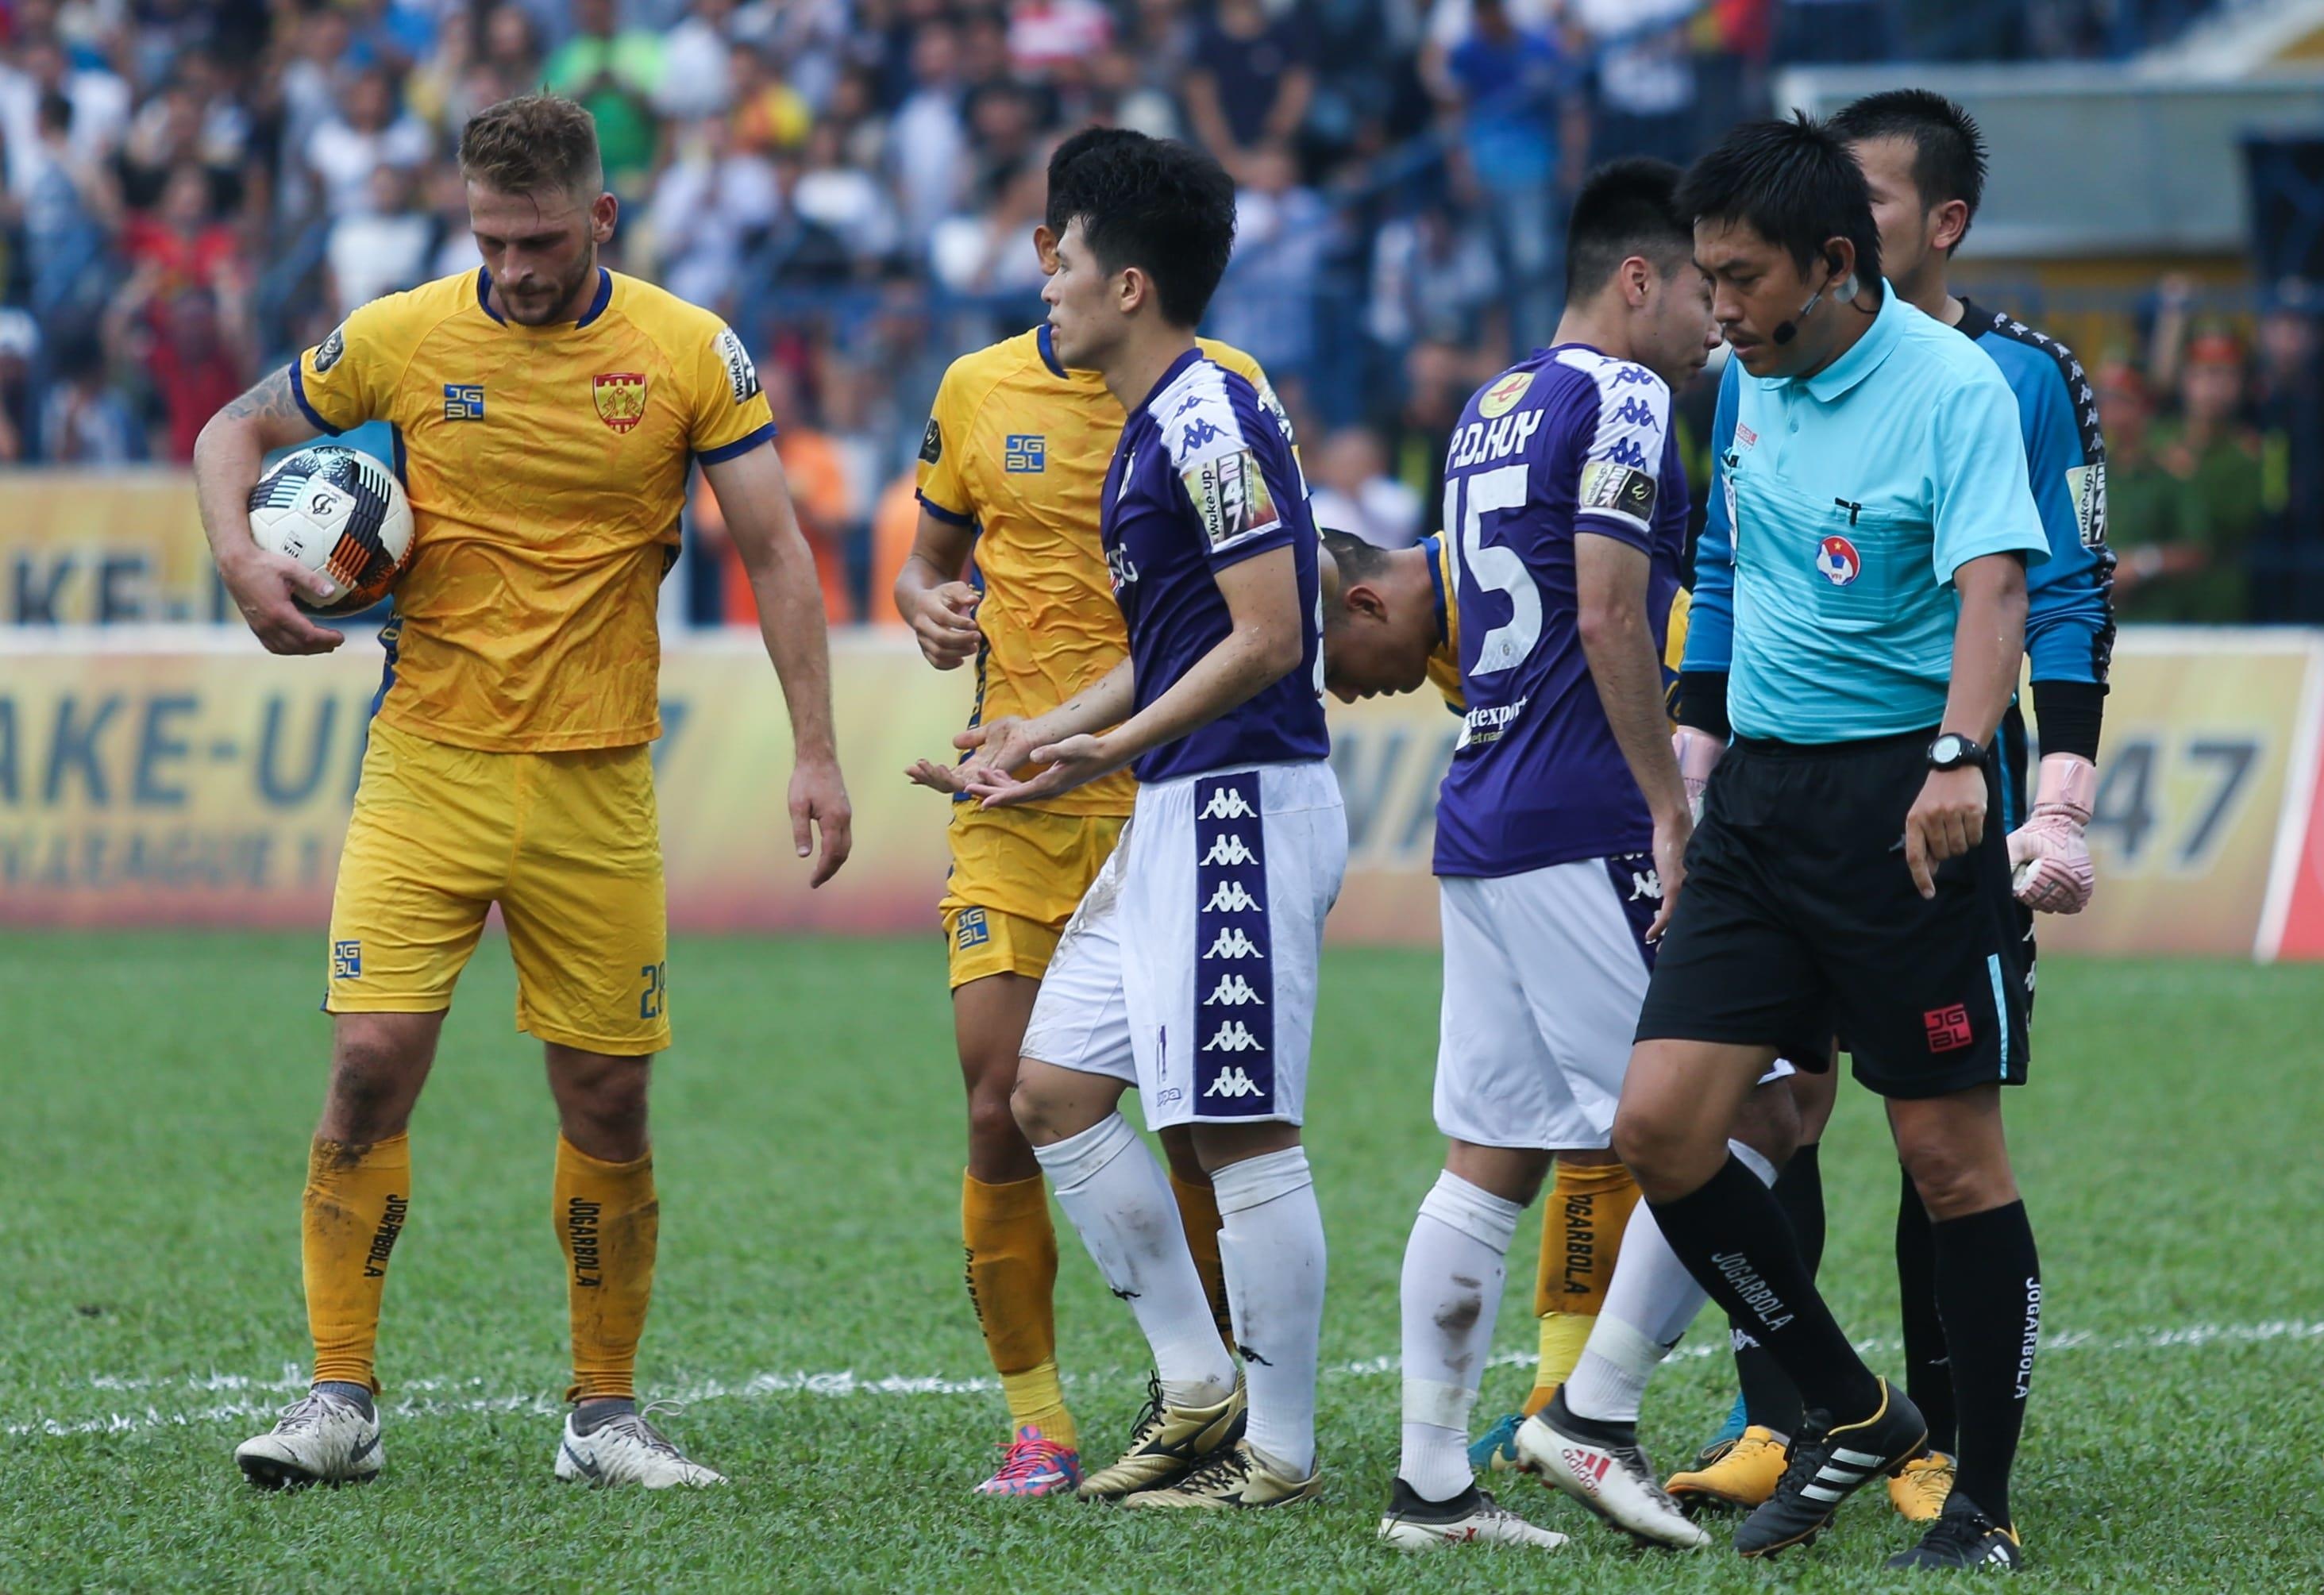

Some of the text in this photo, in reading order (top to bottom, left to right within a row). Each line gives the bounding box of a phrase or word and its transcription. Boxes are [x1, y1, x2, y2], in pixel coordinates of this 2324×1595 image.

[1444, 409, 1544, 475] P.D.HUY
[1202, 470, 1220, 536] wake-up
[1219, 453, 1245, 534] 247
[2081, 472, 2095, 537] wake-up
[1443, 464, 1543, 676] 15
[2027, 740, 2261, 865] 47
[569, 1196, 602, 1287] JOGARBOLA
[1711, 1252, 1794, 1331] JOGARBOLA
[2014, 1277, 2041, 1399] JOGARBOLA
[1562, 1449, 1599, 1498] adidas
